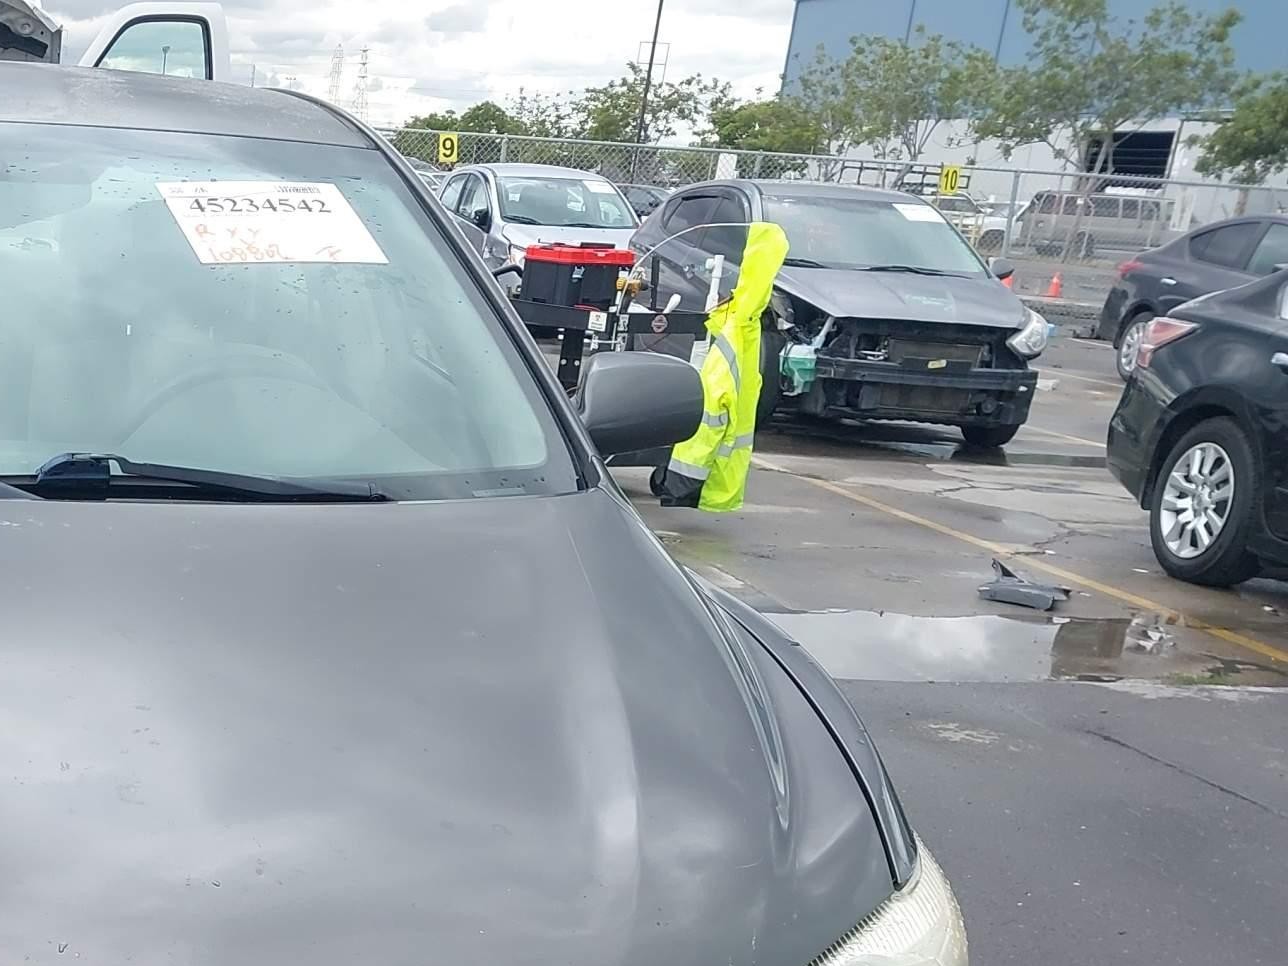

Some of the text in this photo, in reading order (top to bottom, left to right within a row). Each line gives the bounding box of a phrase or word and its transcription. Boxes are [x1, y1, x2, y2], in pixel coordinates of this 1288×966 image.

[442, 137, 455, 158] 9
[944, 169, 958, 190] 10
[189, 198, 332, 214] 45234542
